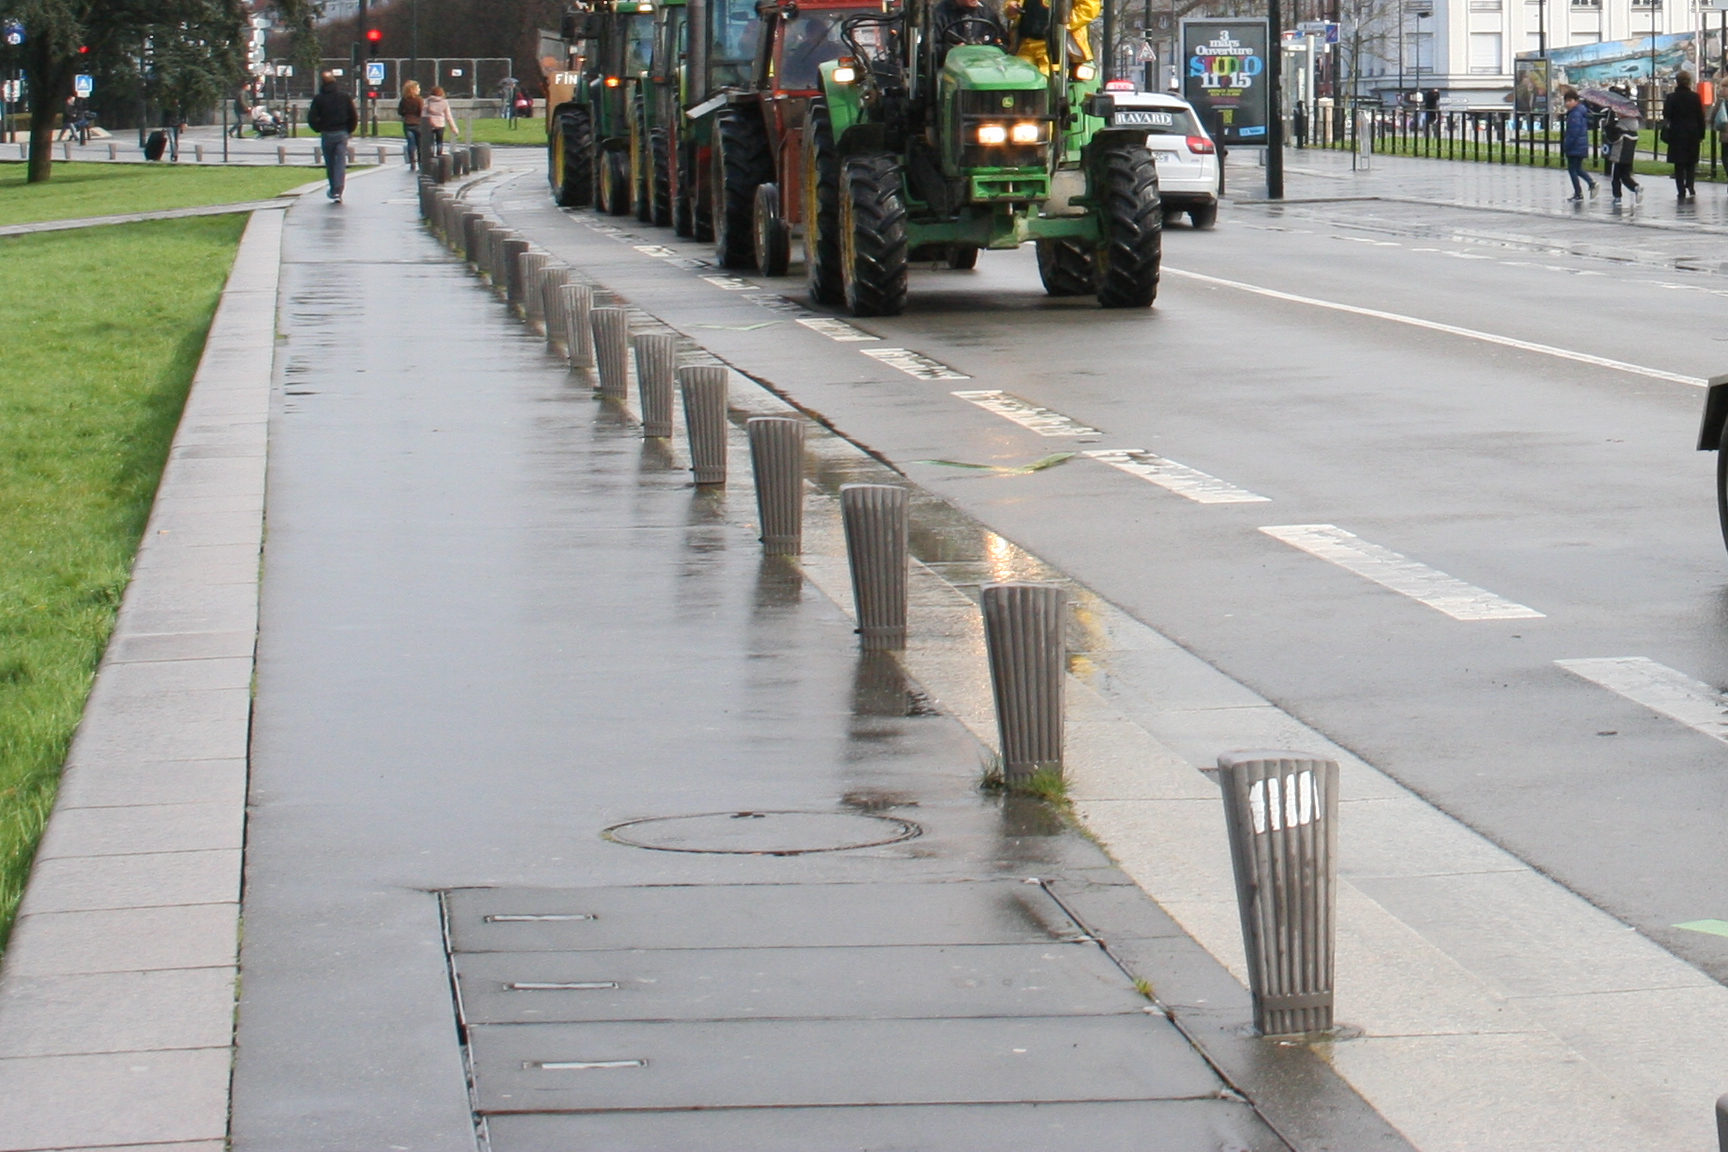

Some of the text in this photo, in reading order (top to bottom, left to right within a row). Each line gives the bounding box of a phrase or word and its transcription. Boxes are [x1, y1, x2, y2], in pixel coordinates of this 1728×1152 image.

[1219, 30, 1230, 41] 3
[1195, 45, 1254, 55] Ouverture
[555, 72, 578, 84] FIN
